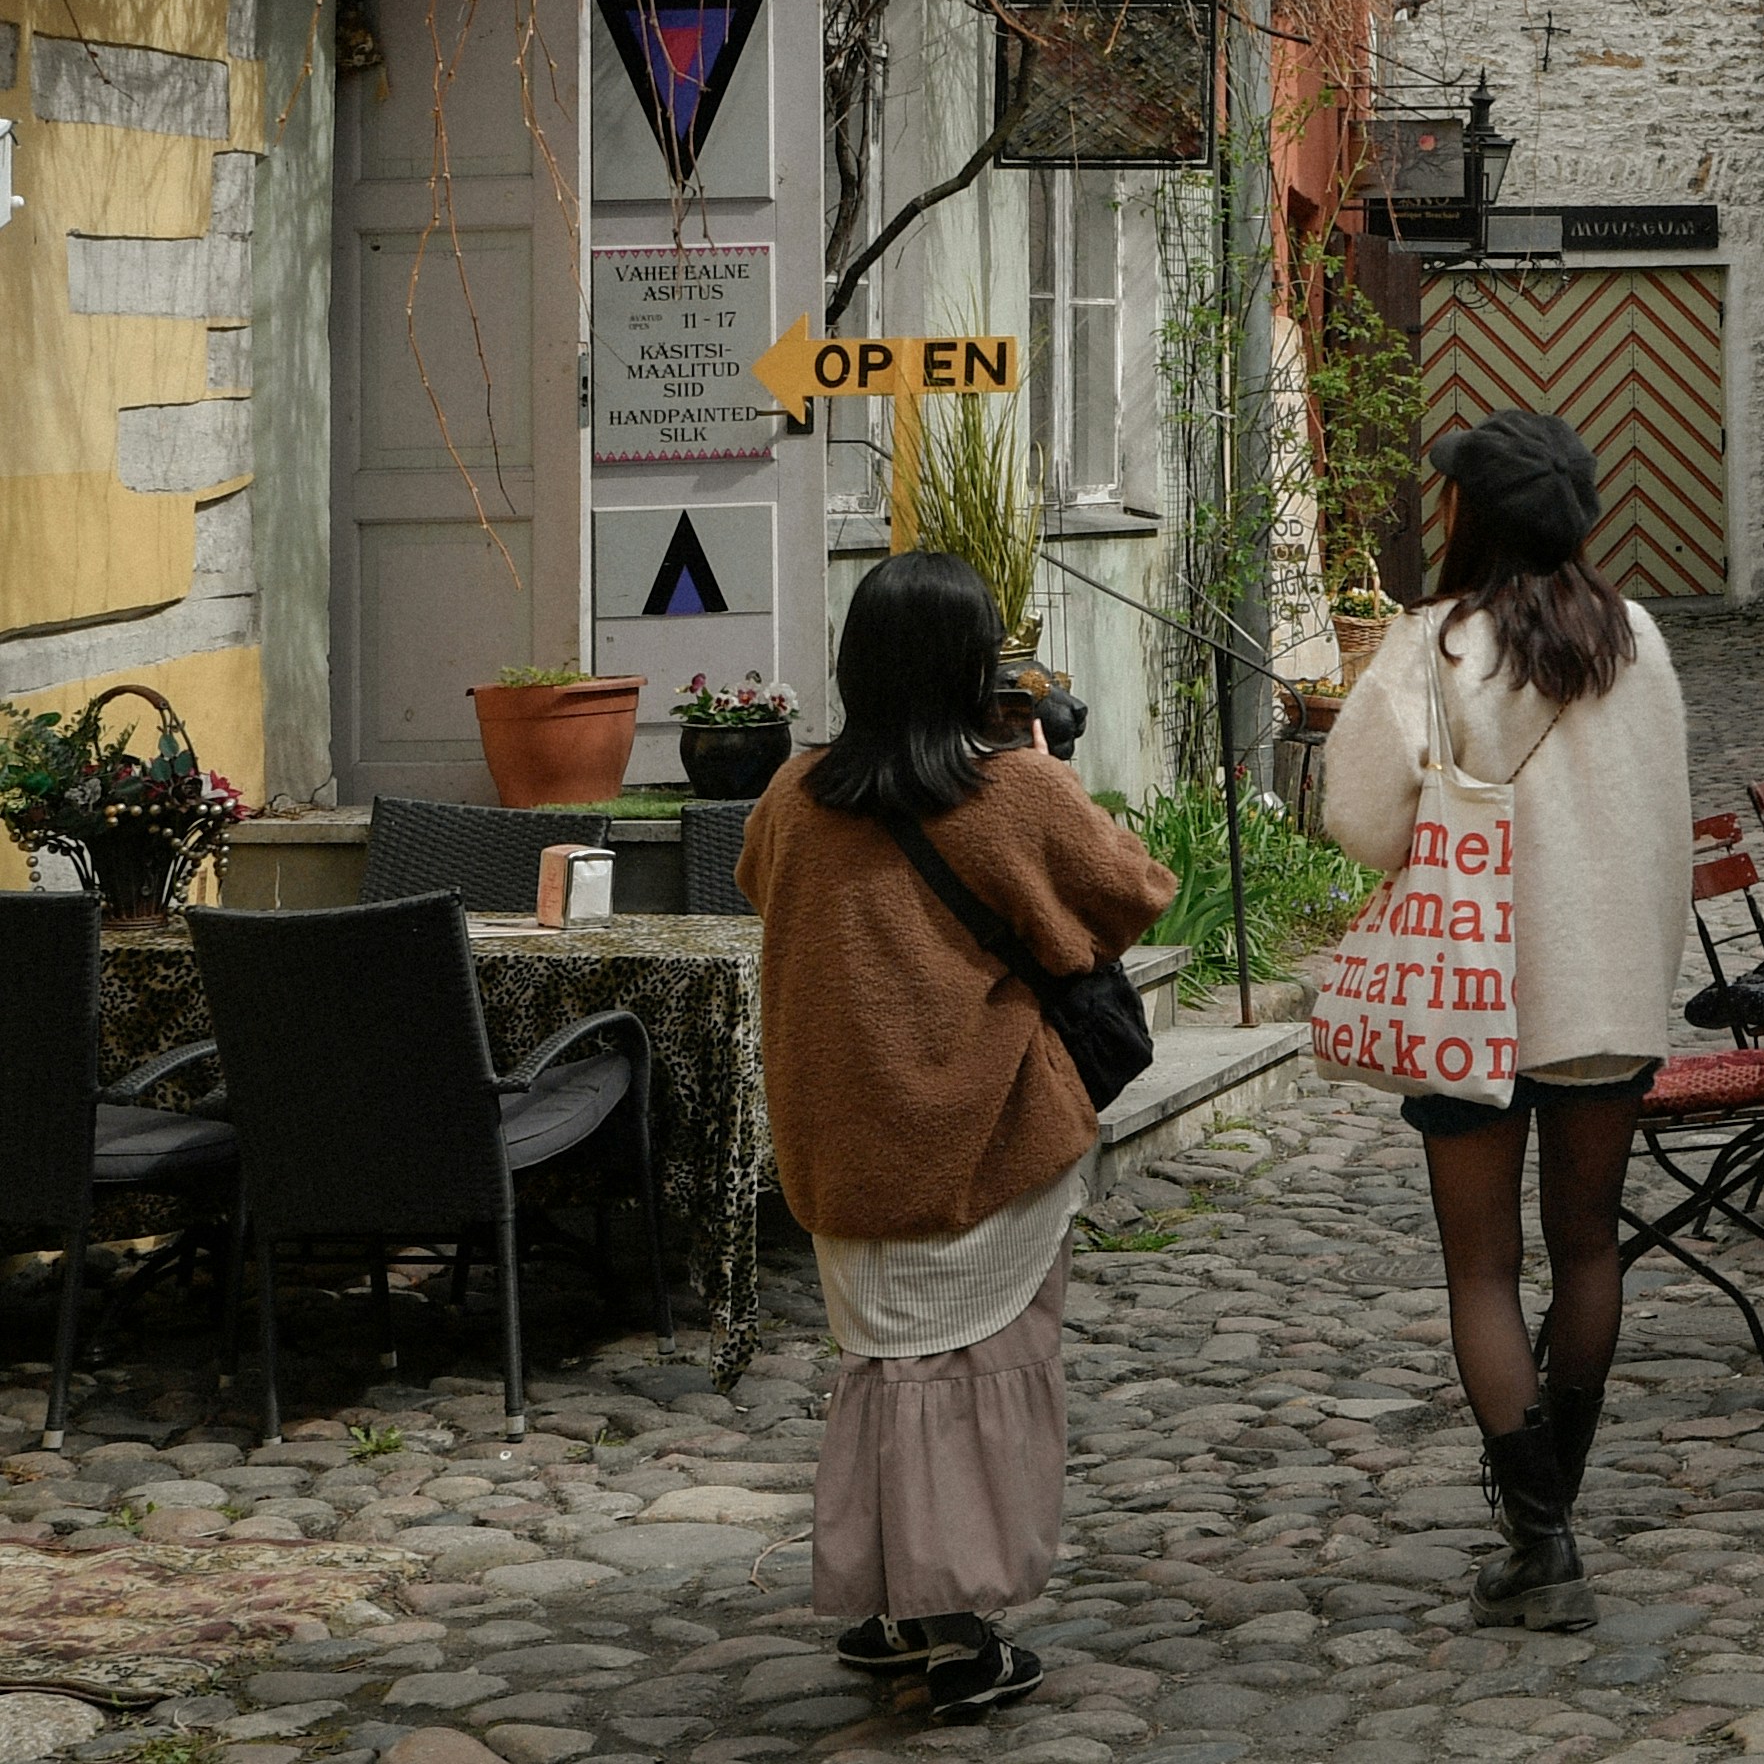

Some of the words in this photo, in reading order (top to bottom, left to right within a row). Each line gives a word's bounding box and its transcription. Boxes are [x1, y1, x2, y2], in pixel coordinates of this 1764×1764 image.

[643, 284, 724, 302] ASUTUS
[681, 312, 697, 329] 11
[716, 311, 737, 329] 17
[640, 342, 733, 361] KÄSITSI-
[627, 362, 740, 380] MAALITUD
[663, 382, 704, 398] SIID
[609, 407, 758, 426] HANDPAINTED
[660, 427, 708, 443] SILK
